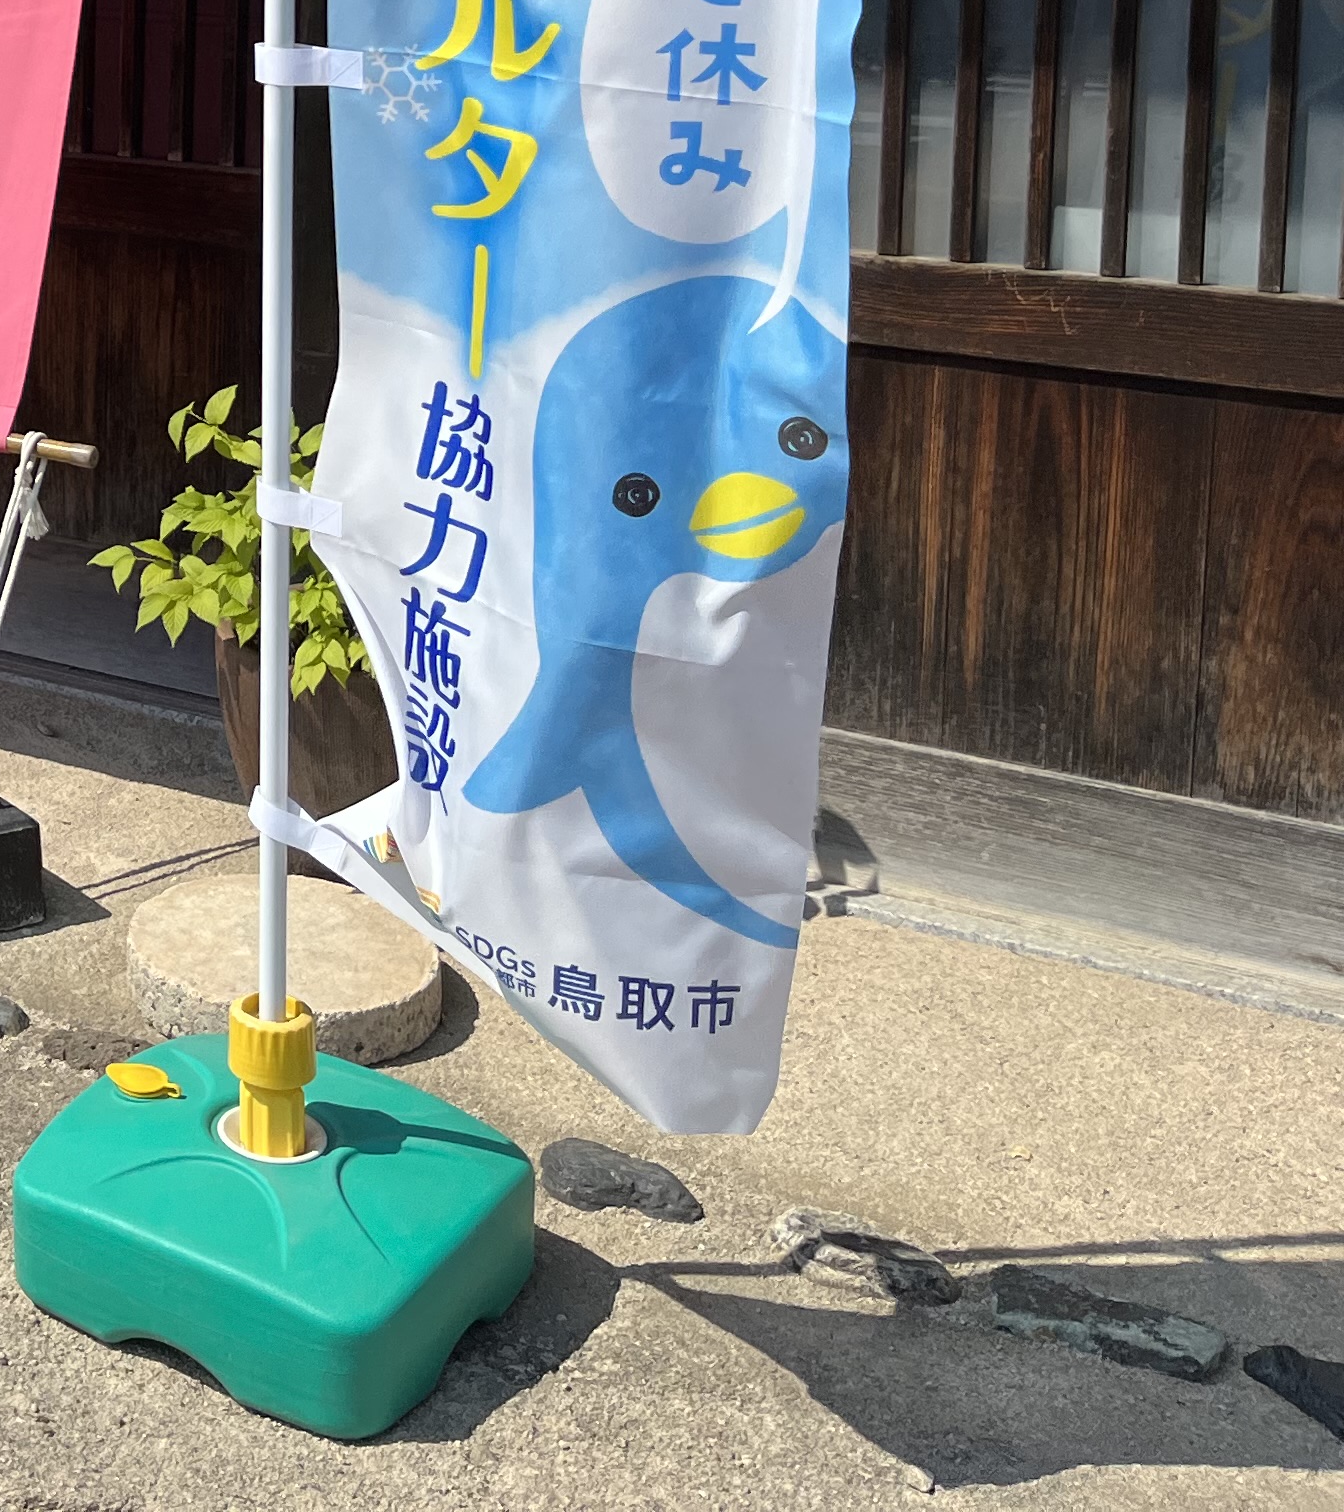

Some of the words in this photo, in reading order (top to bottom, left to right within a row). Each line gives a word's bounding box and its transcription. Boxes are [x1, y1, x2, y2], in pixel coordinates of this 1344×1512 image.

[401, 380, 494, 816] 協力施設
[454, 926, 537, 979] SDGs
[547, 965, 743, 1035] 鳥取市
